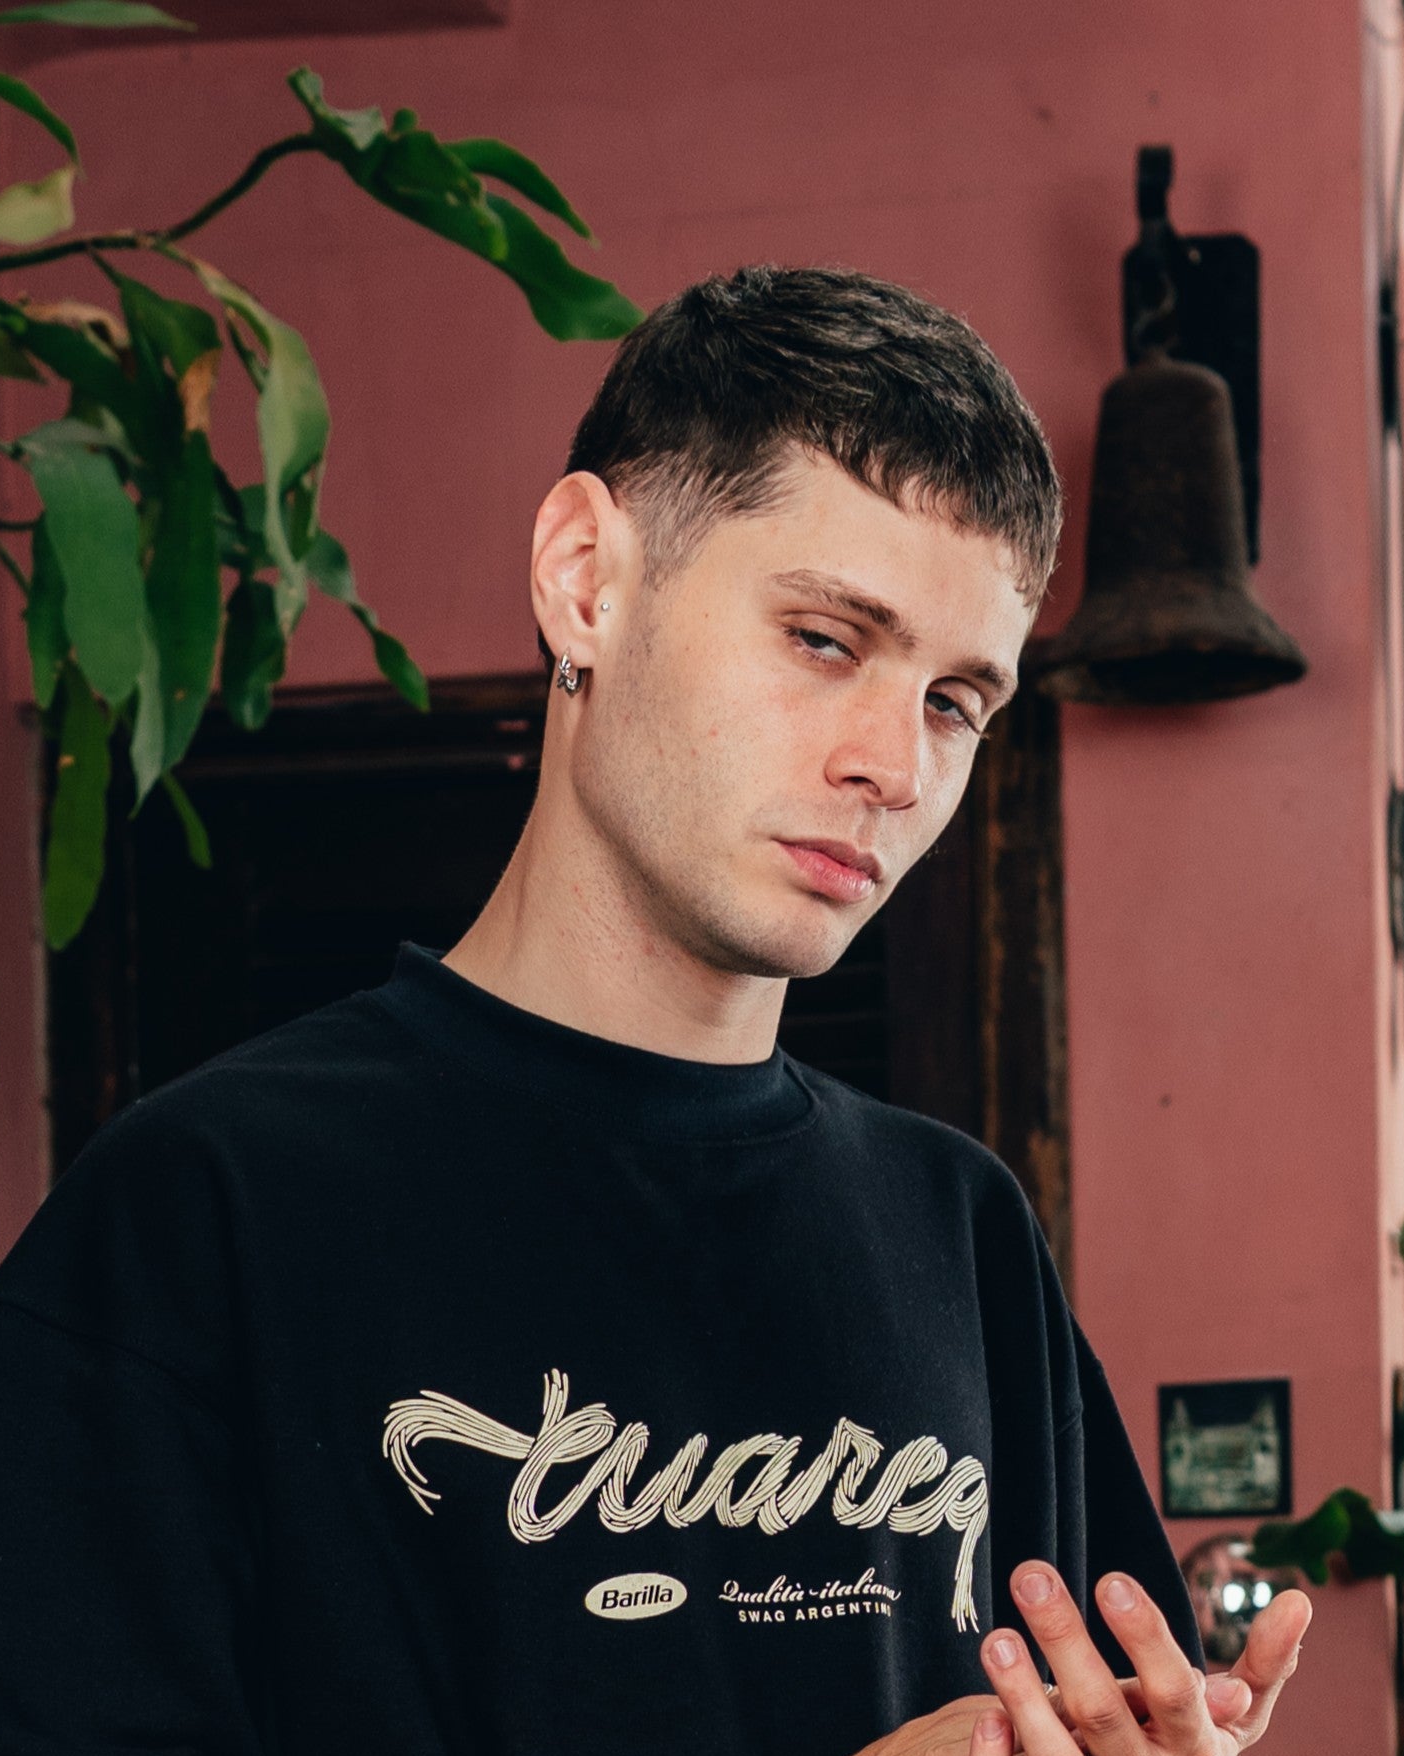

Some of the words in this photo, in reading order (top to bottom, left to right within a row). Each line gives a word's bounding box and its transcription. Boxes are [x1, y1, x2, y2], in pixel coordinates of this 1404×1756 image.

[600, 1583, 674, 1611] Barilla
[718, 1574, 805, 1604] Qualità
[738, 1609, 786, 1623] SWAG
